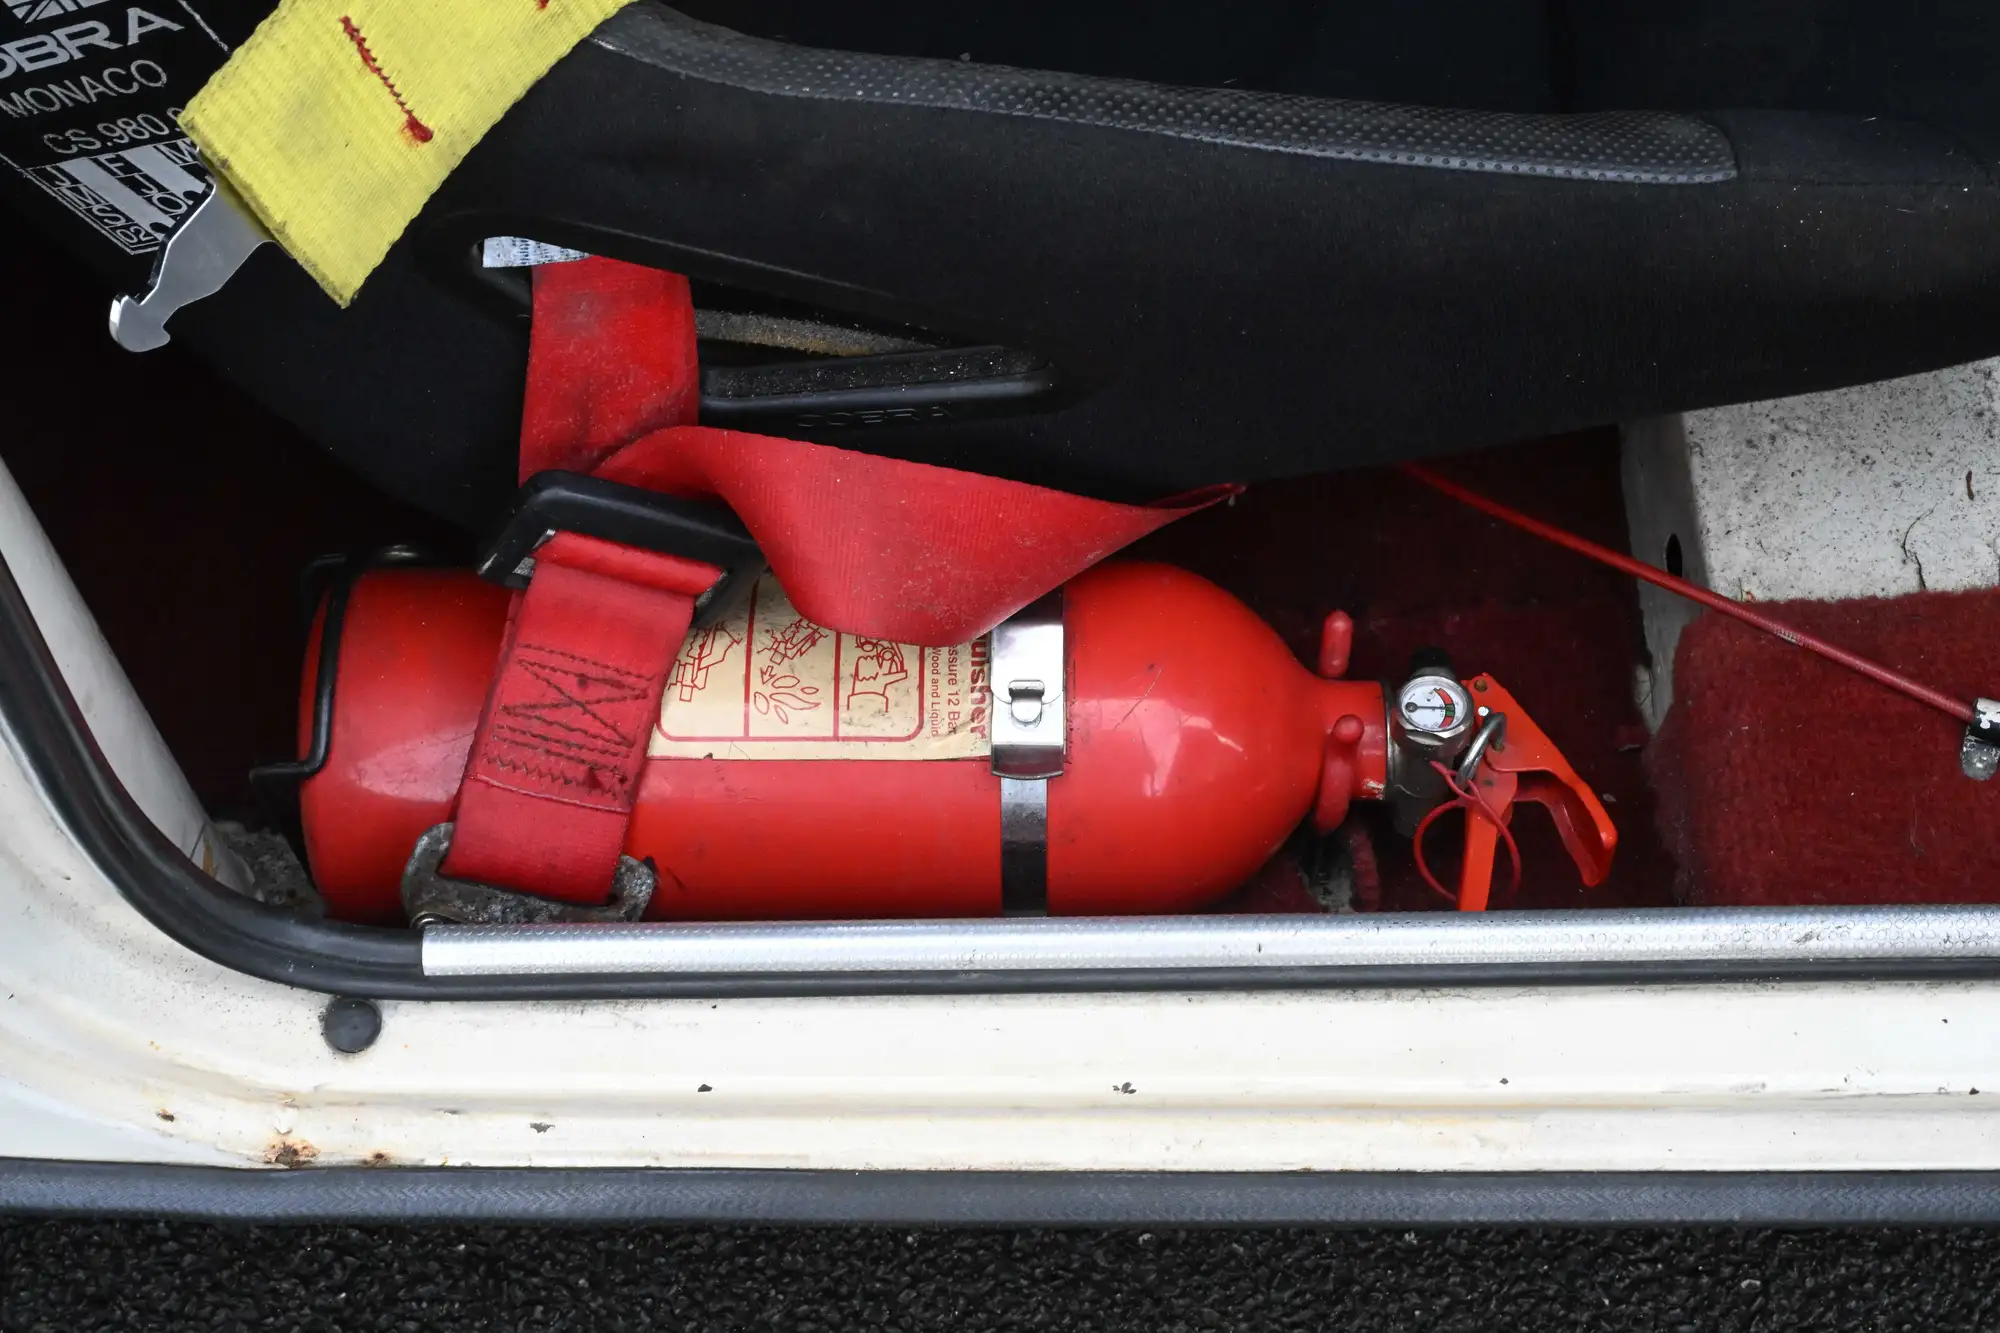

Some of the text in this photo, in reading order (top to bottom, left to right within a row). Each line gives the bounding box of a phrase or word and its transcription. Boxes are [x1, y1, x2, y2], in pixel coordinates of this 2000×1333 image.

[0, 59, 168, 118] MONACO
[931, 647, 941, 675] Wood
[931, 679, 941, 698] and
[947, 691, 960, 706] 12
[947, 711, 960, 735] Bar
